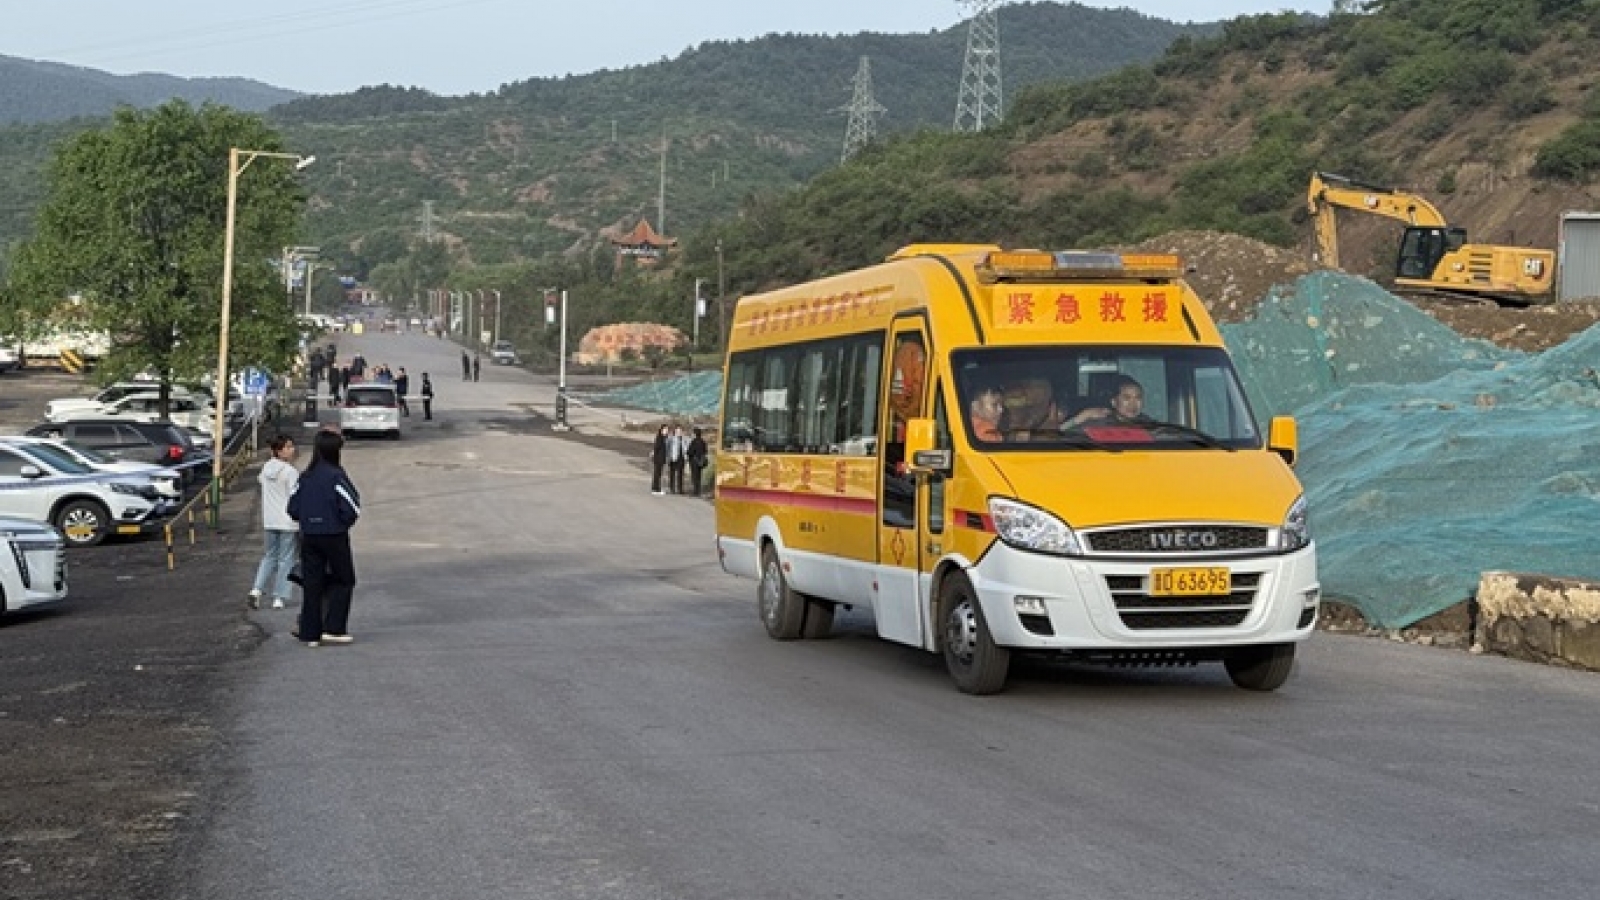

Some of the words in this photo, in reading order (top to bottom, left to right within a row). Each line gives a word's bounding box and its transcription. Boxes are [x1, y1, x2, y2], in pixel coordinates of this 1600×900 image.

[1008, 291, 1168, 324] 紧急救援
[1150, 530, 1217, 548] IVECO
